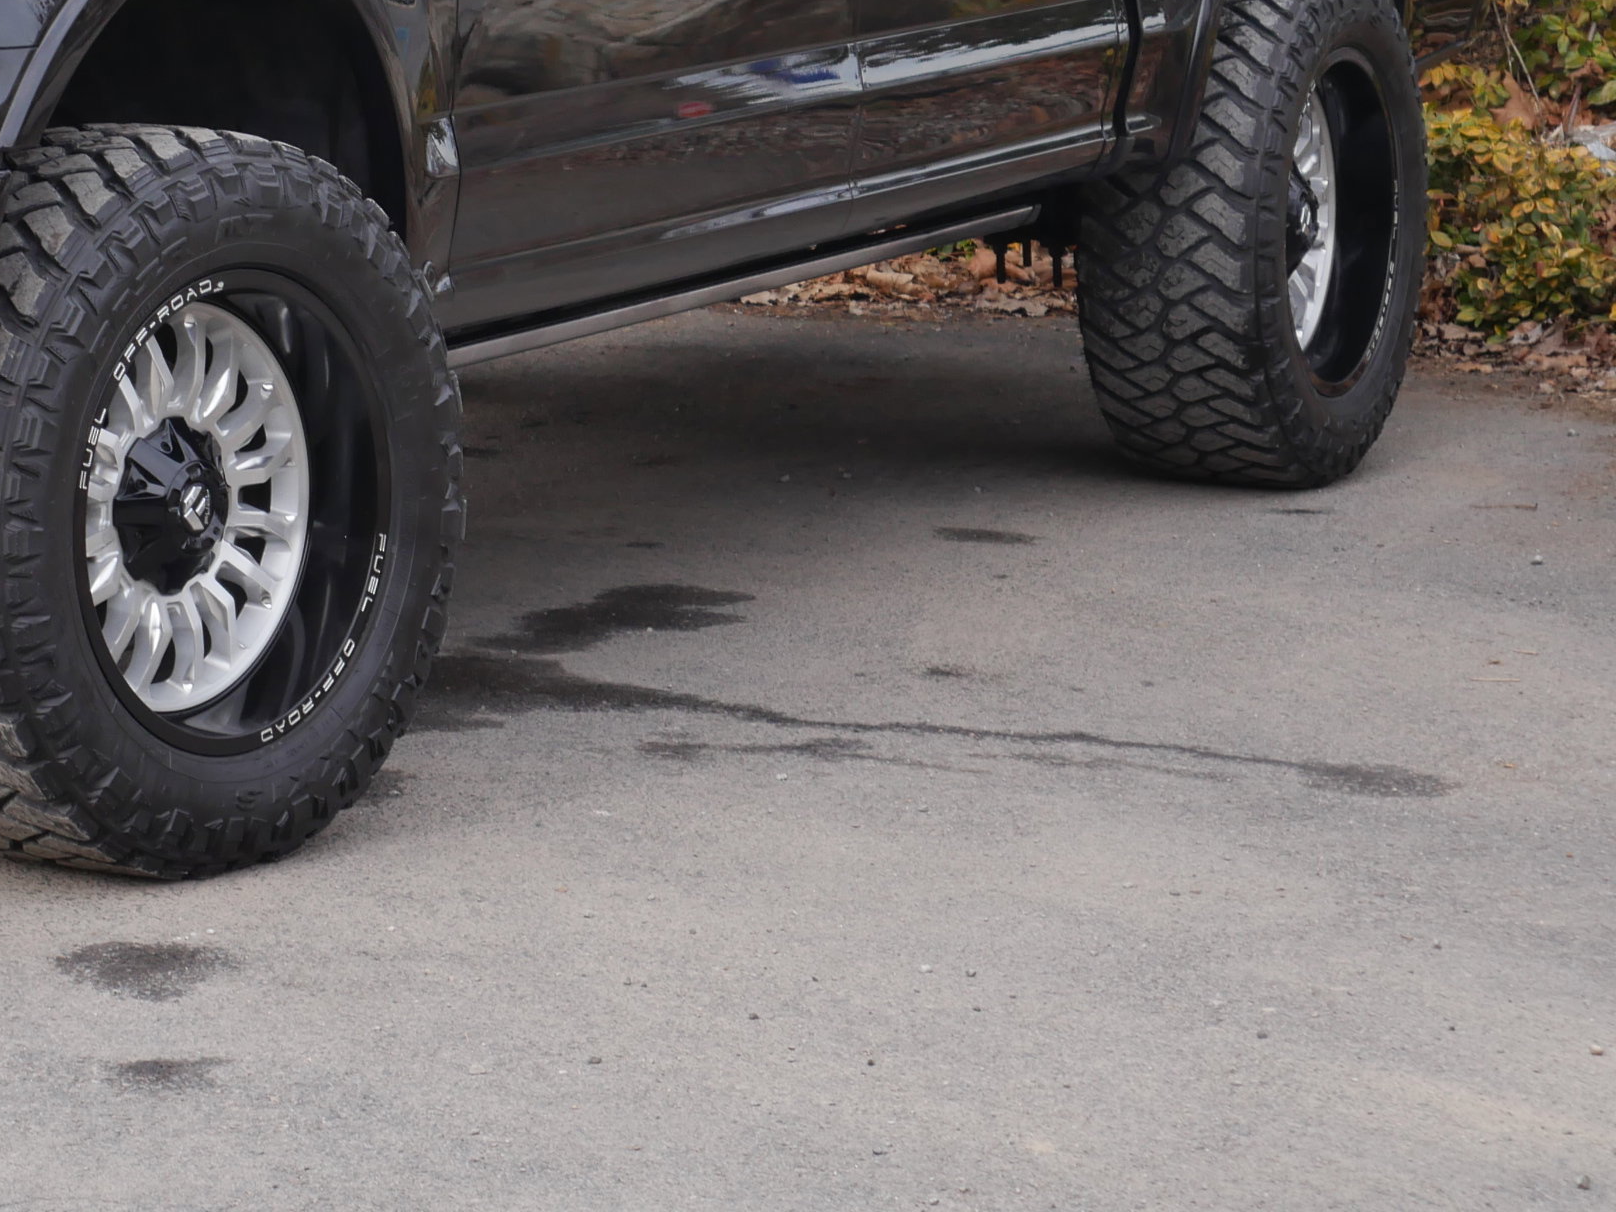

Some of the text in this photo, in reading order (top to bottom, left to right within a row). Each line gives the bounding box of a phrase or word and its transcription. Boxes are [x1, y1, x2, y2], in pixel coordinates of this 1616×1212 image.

[80, 408, 106, 489] FUEL
[114, 279, 212, 382] OFF-ROAD
[261, 533, 387, 742] FUEL OFF-ROAD
